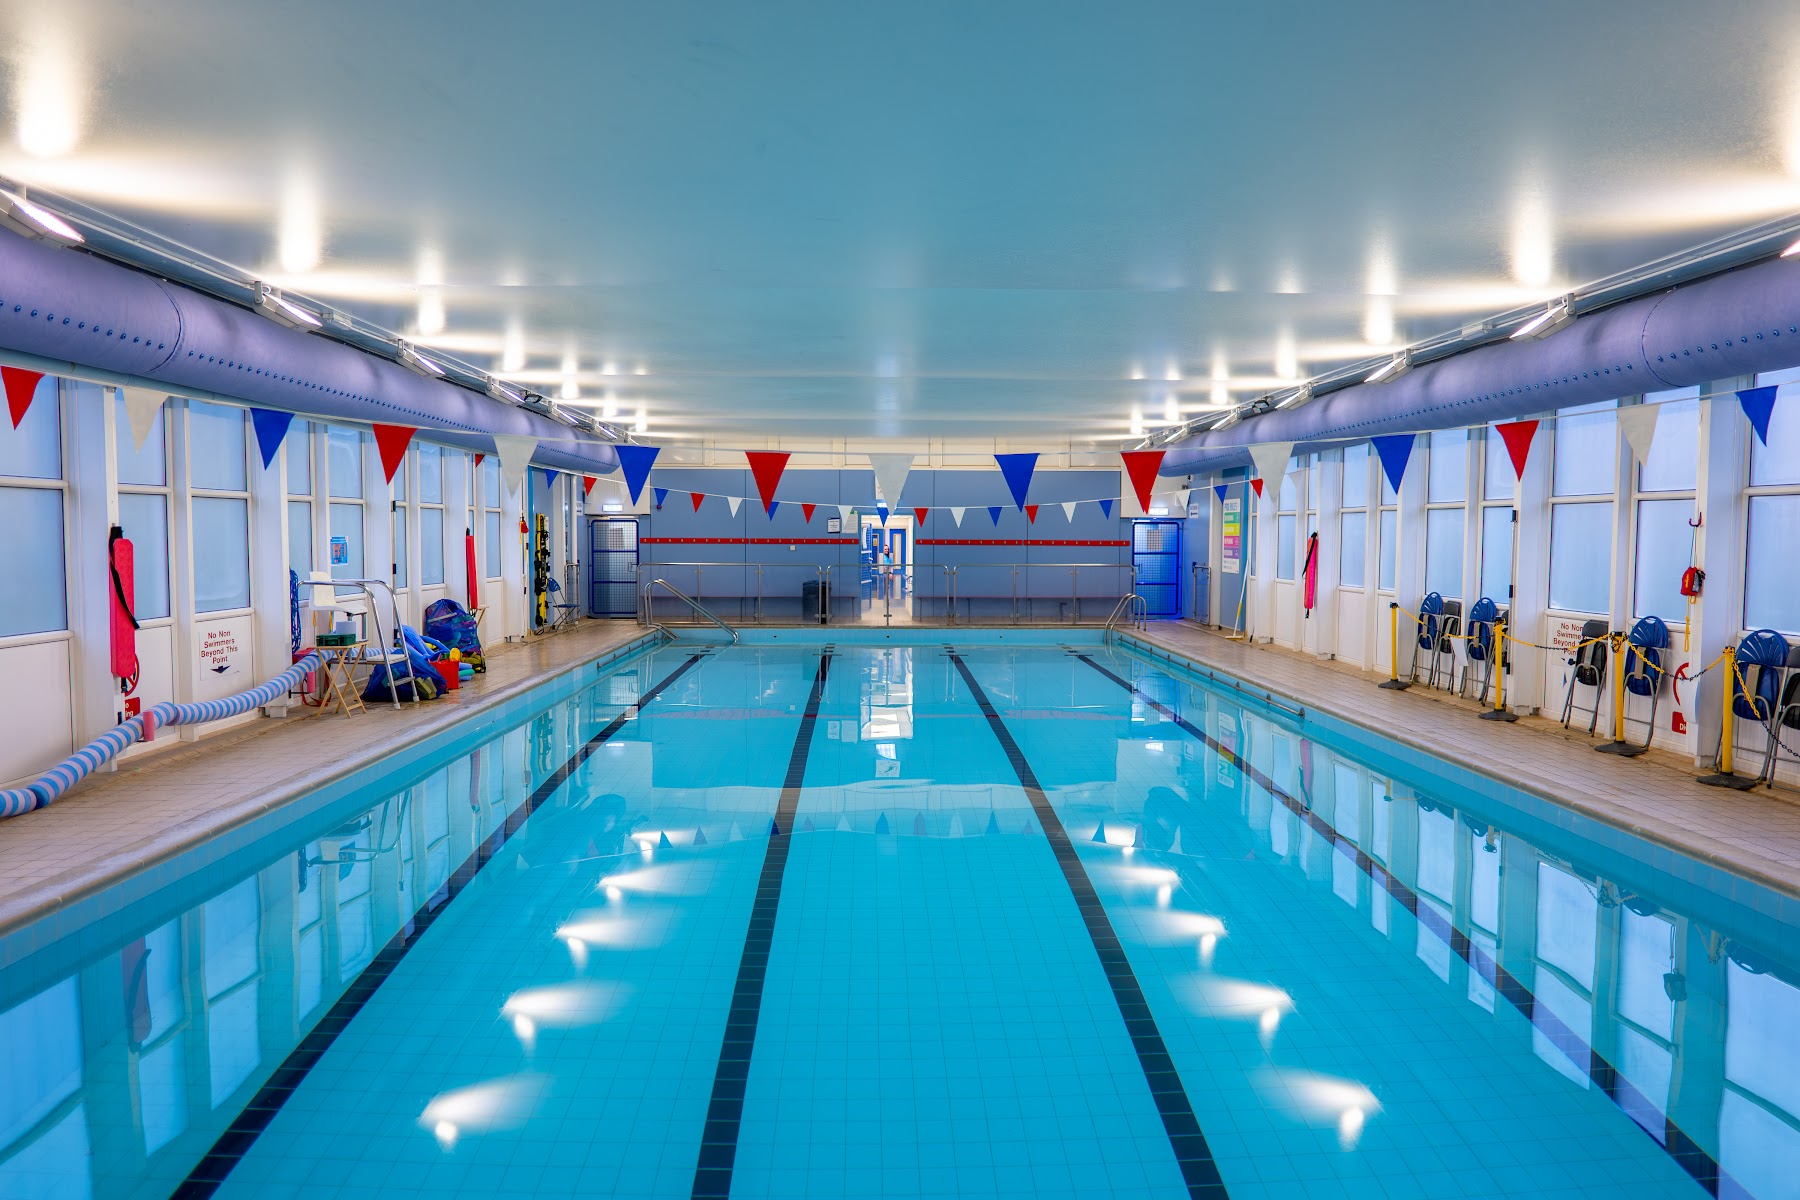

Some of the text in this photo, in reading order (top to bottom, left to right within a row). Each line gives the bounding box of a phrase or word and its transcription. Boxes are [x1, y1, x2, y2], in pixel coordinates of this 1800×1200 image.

[1561, 622, 1570, 630] No
[207, 630, 231, 639] No Non
[1556, 629, 1582, 641] Swimme
[204, 638, 235, 649] Swimmers
[1553, 637, 1576, 647] Beyond
[201, 645, 238, 658] Beyond This
[1563, 648, 1577, 656] Poin
[212, 656, 228, 664] Point
